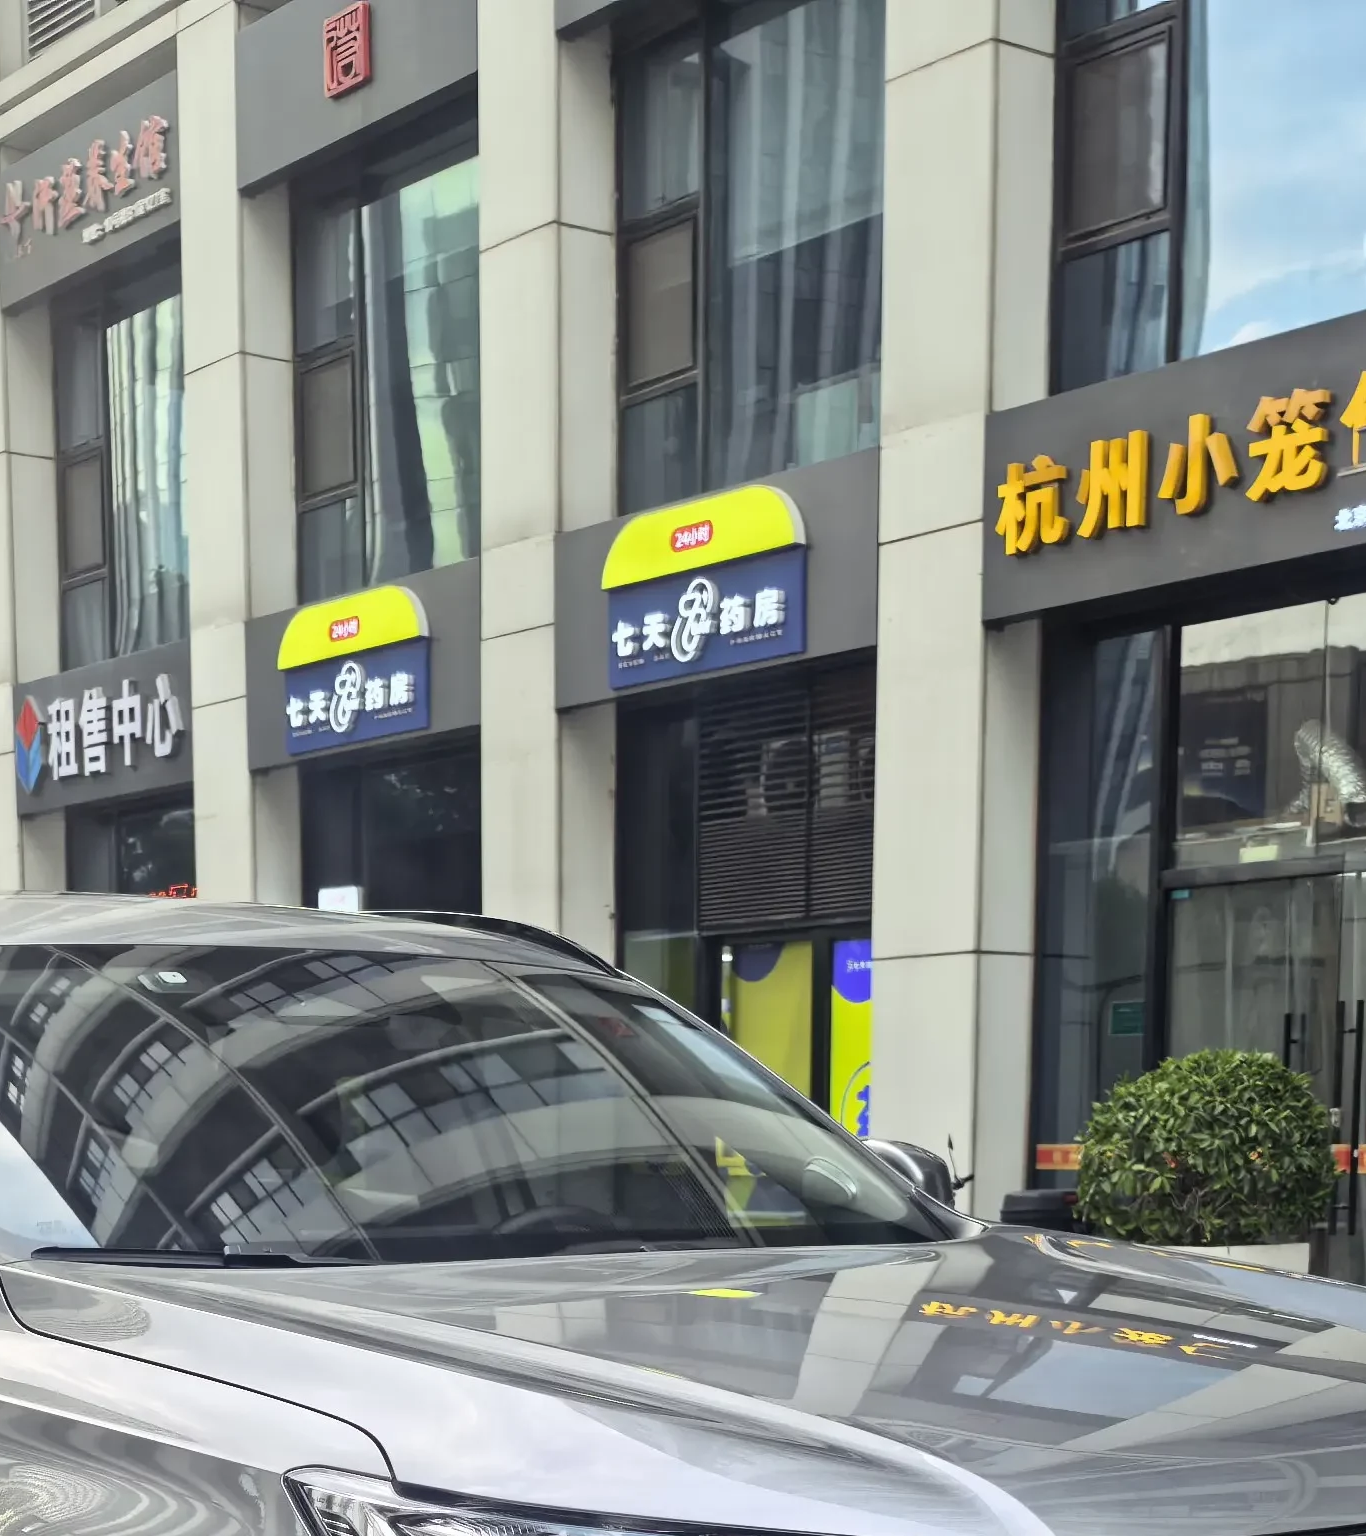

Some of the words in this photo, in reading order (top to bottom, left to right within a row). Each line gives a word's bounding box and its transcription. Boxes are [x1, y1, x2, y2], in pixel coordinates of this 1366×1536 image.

[675, 524, 710, 549] 24小时
[47, 674, 184, 780] 租售中心
